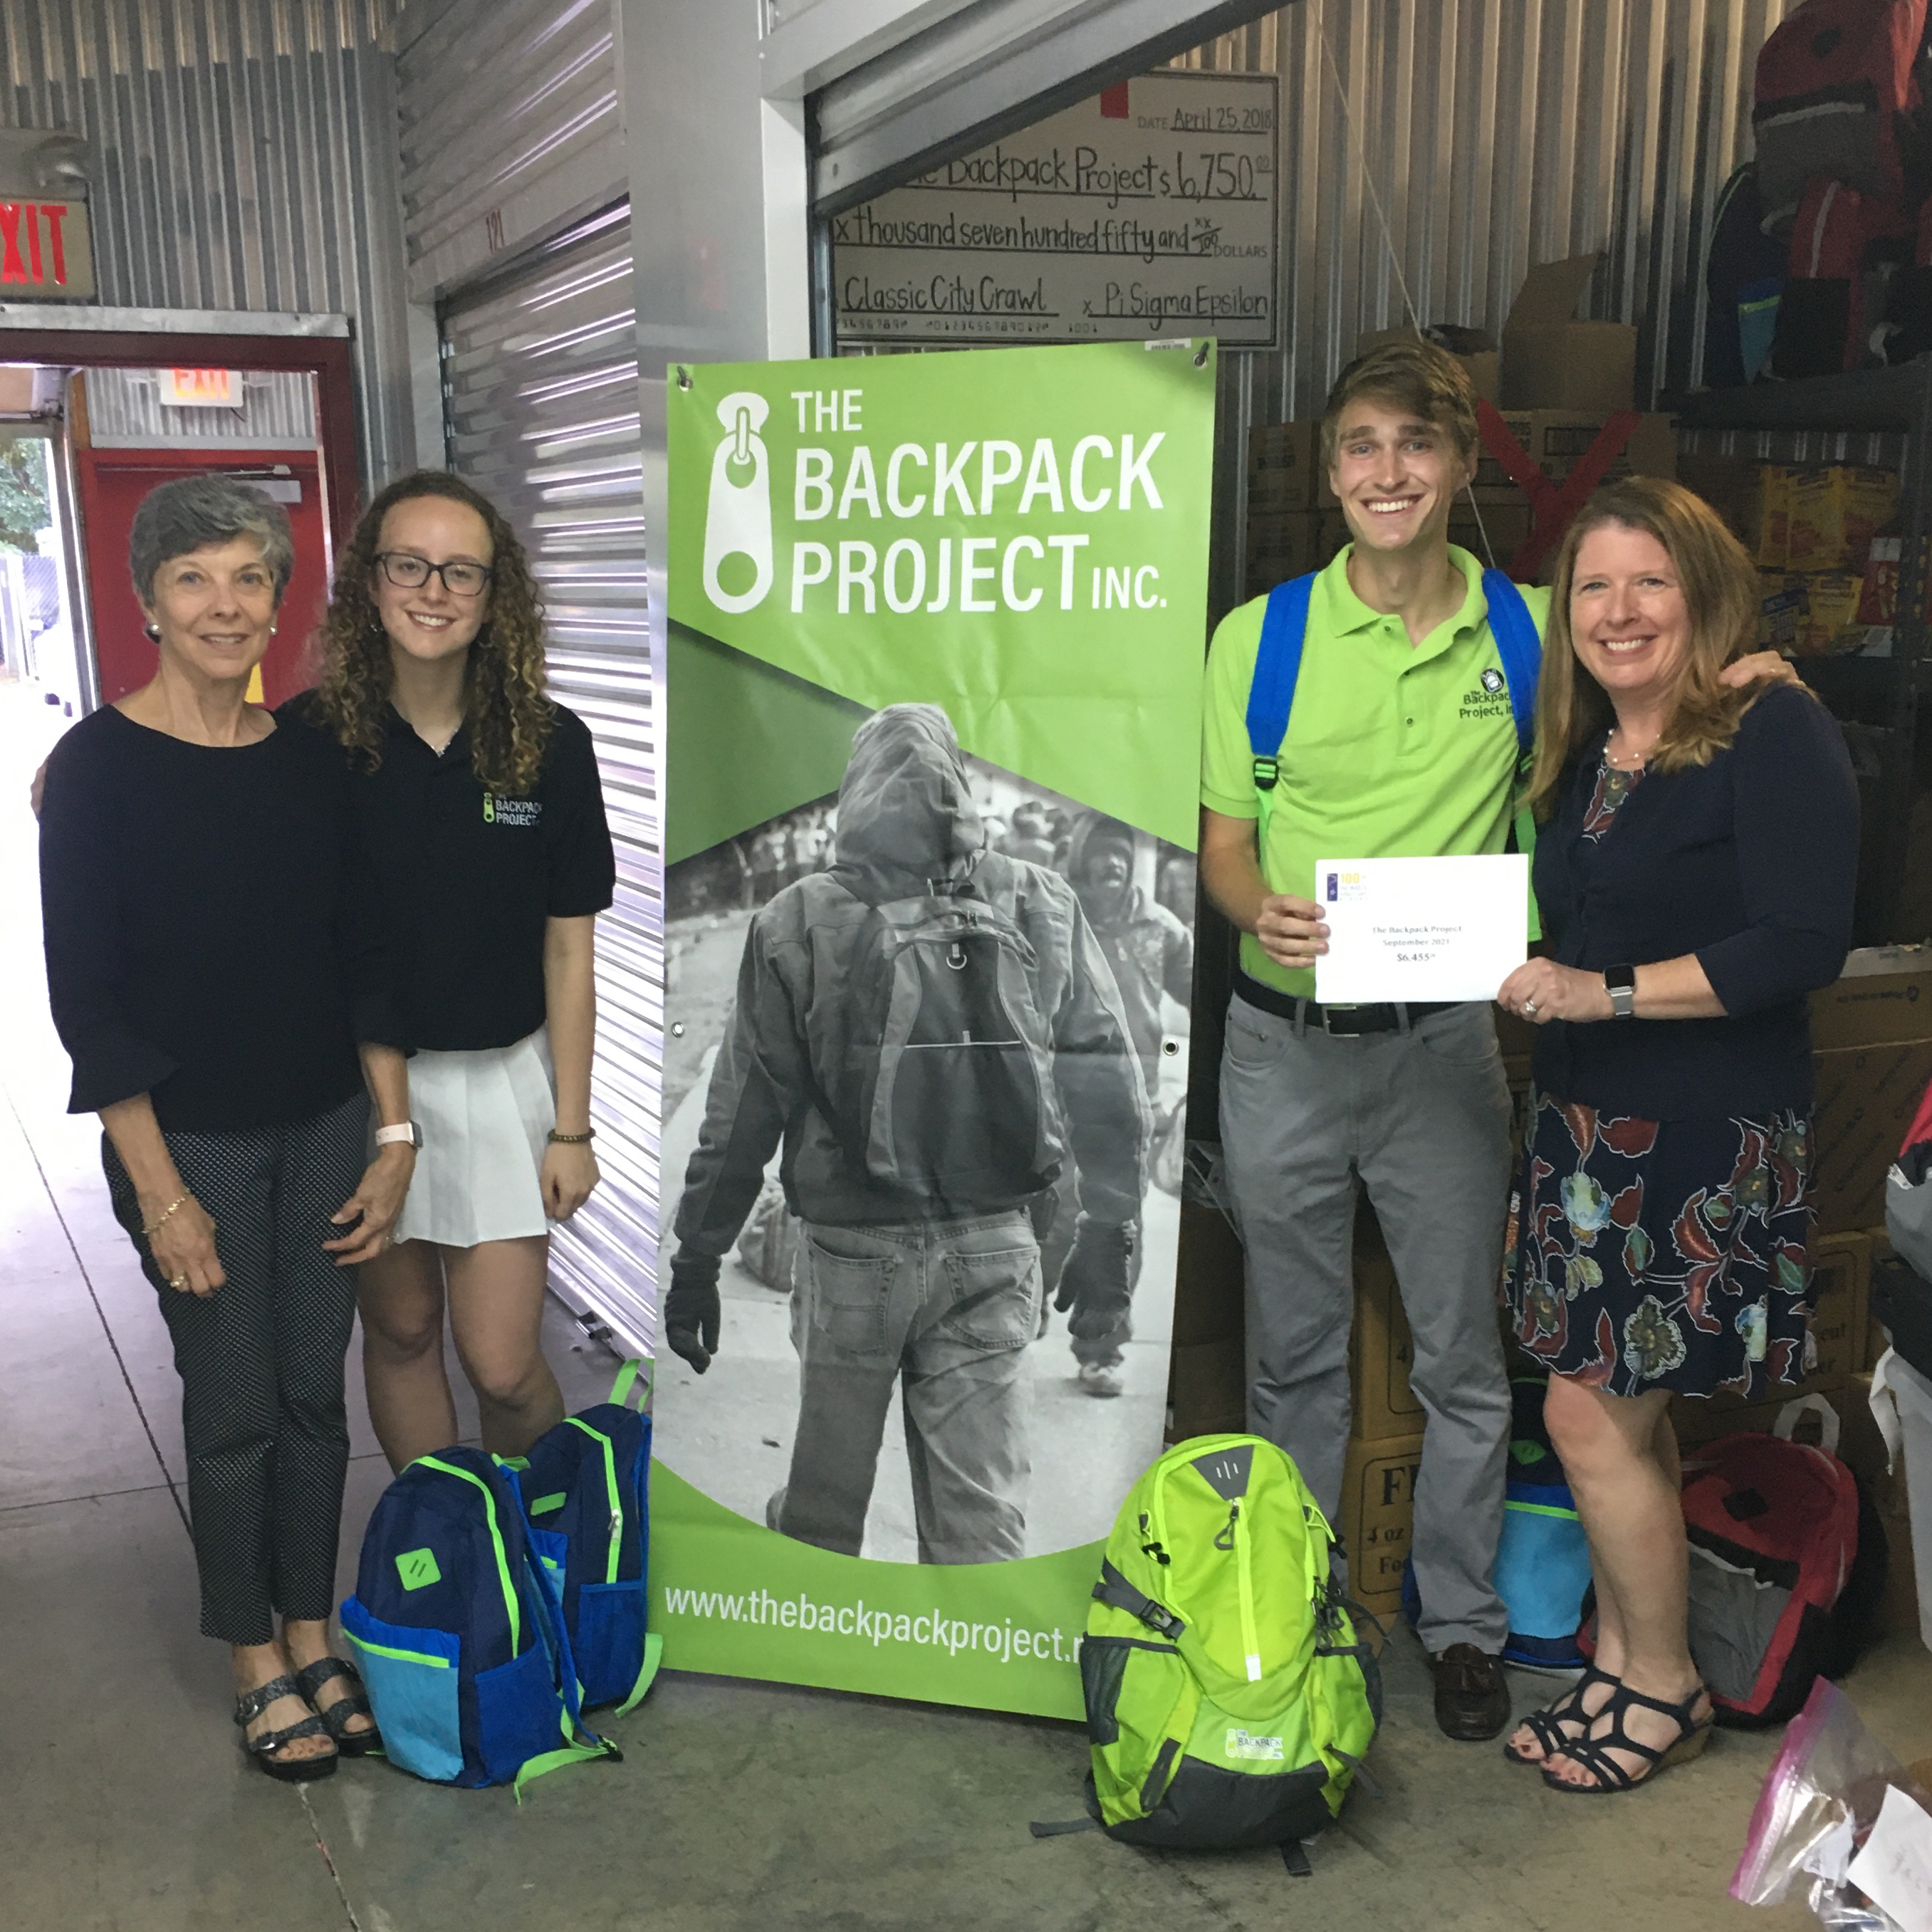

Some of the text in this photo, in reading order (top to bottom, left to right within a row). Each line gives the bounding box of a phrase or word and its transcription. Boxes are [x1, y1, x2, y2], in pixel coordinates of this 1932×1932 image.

[1174, 108, 1211, 131] April
[1242, 108, 1273, 130] 2018
[1075, 146, 1159, 209] Project
[0, 203, 68, 284] XIT
[835, 218, 850, 241] x
[855, 204, 956, 244] thousand
[961, 222, 1017, 247] seven
[1020, 216, 1098, 252] hundred
[1102, 219, 1154, 263] fifty
[1159, 223, 1189, 251] and
[1213, 244, 1268, 258] DOLLARS
[845, 275, 1047, 314] Classic City Crawl
[1106, 281, 1123, 315] Pi
[1131, 282, 1191, 331] Sigma
[1196, 285, 1268, 326] Epsilon
[791, 389, 863, 433] THE
[794, 432, 1166, 521] BACKPACK
[790, 534, 1167, 615] PROJECT INC.
[1459, 705, 1504, 719] Project,
[1463, 691, 1510, 705] Backpac
[1382, 939, 1429, 947] September
[1389, 926, 1429, 934] Backpack
[1431, 925, 1462, 934] Project
